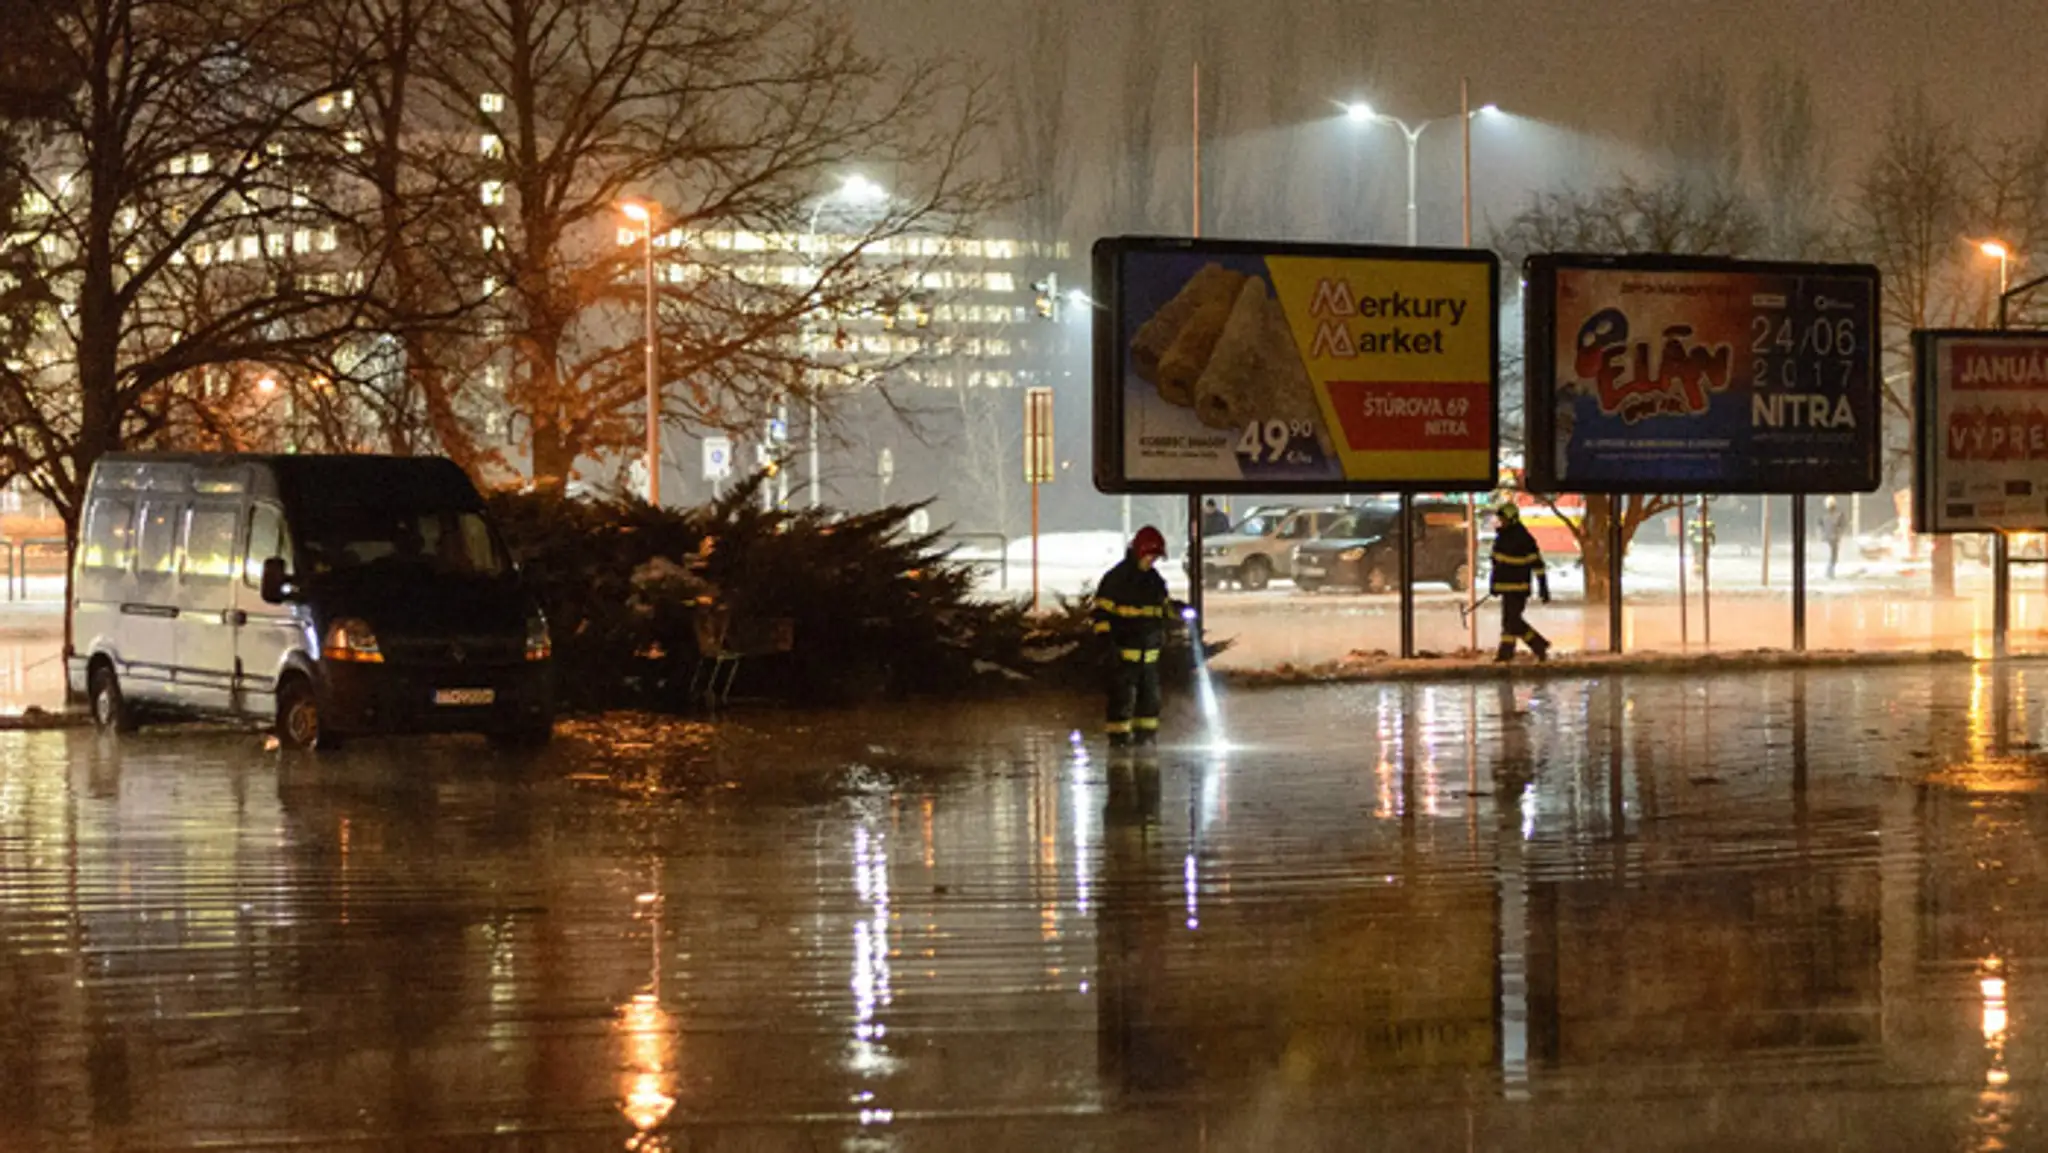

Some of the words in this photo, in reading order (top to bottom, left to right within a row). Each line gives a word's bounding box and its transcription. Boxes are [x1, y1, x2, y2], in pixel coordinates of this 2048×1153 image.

[1309, 278, 1467, 326] Merkury
[1309, 319, 1445, 360] Market
[1752, 315, 1856, 355] 24/06
[1446, 397, 1469, 418] 69
[1751, 393, 1857, 428] NITRA
[1424, 419, 1468, 437] NITRA
